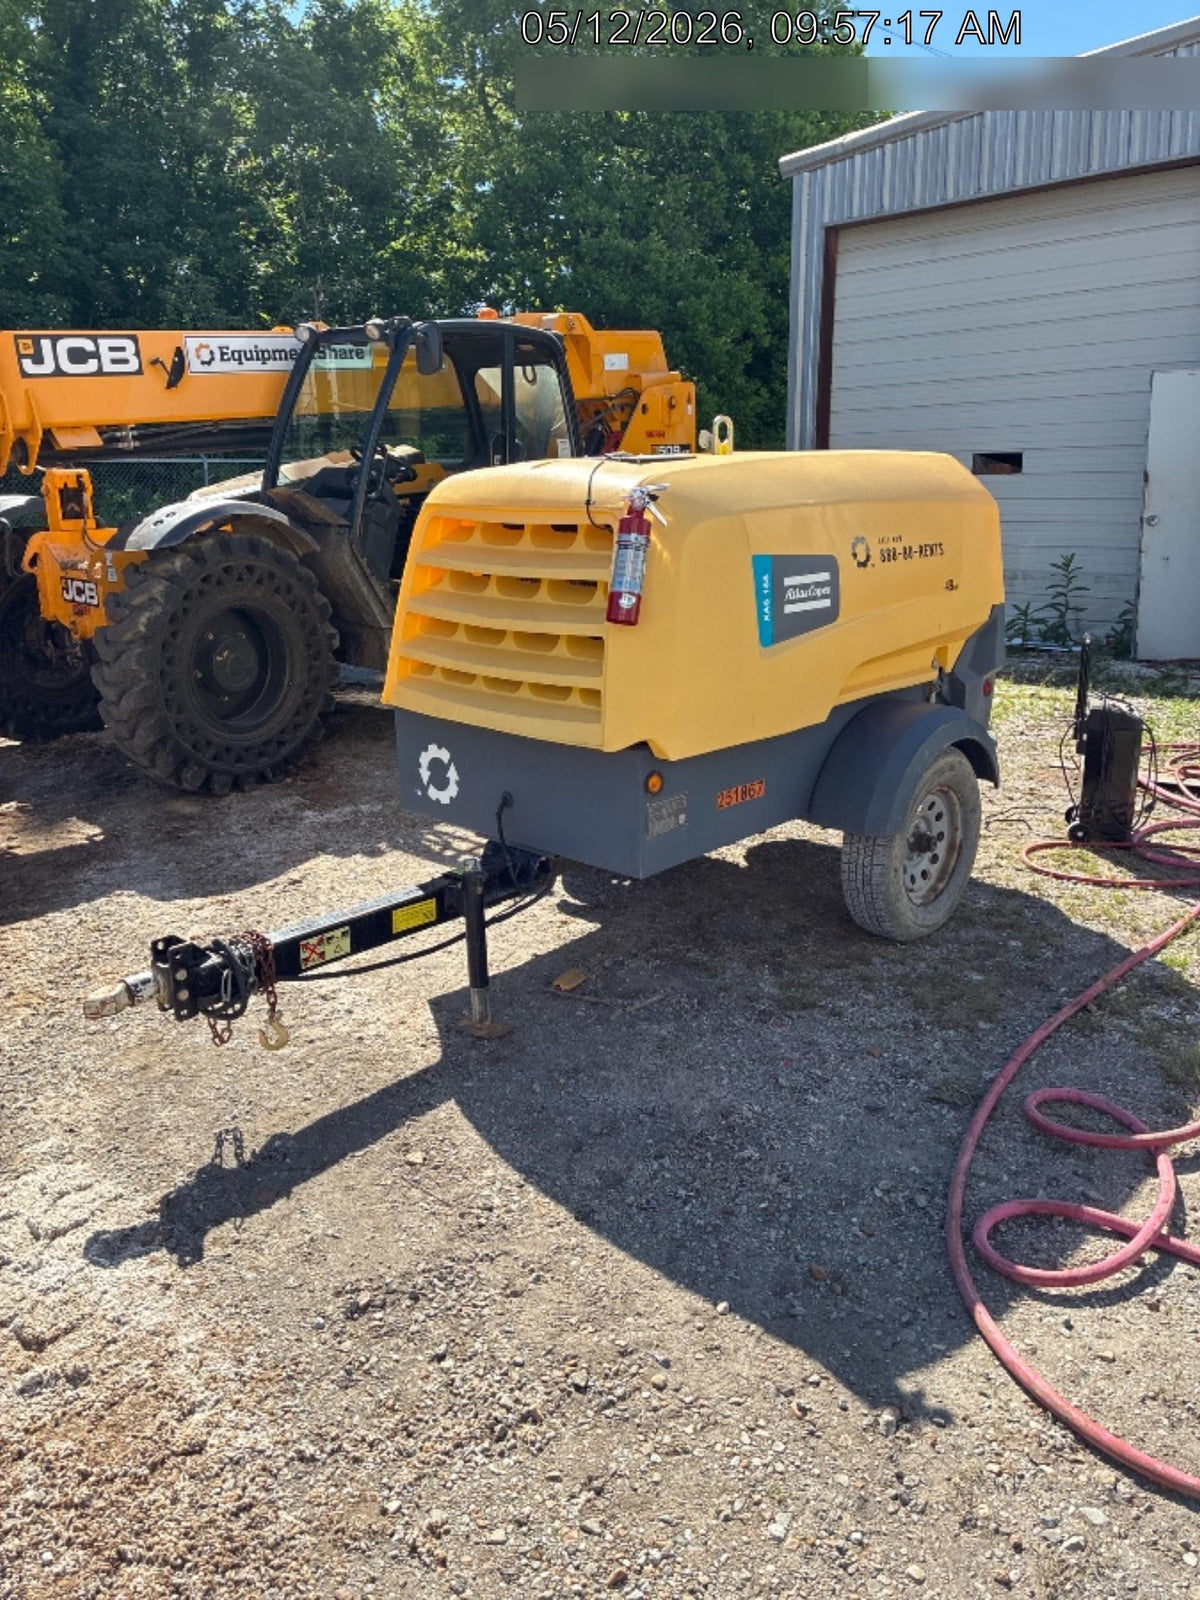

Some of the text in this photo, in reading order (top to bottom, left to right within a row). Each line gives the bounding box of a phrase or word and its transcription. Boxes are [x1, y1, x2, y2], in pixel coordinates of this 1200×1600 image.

[20, 337, 141, 375] JCB
[218, 344, 366, 365] EquipmeShare
[63, 579, 99, 606] JCB
[718, 780, 765, 808] 251867
